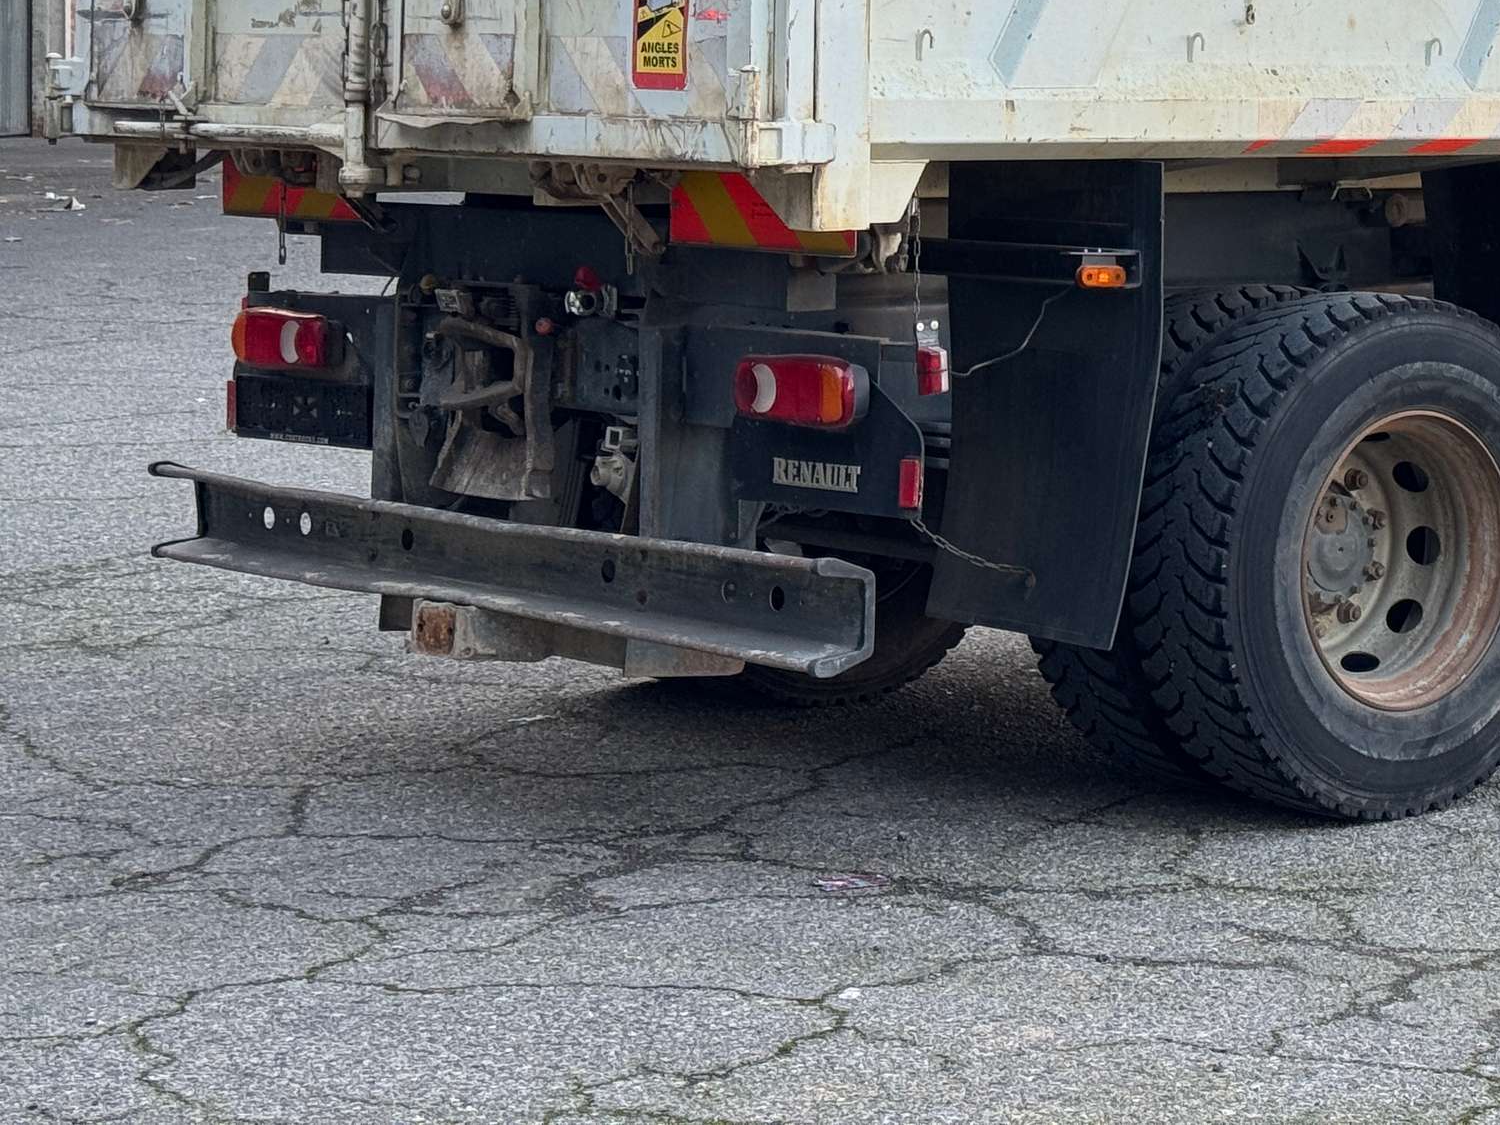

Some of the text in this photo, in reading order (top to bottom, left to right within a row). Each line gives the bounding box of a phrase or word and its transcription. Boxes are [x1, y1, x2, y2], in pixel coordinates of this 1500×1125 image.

[641, 41, 679, 54] ANGLES
[643, 56, 677, 68] MORTS
[773, 457, 861, 493] RENAULT
